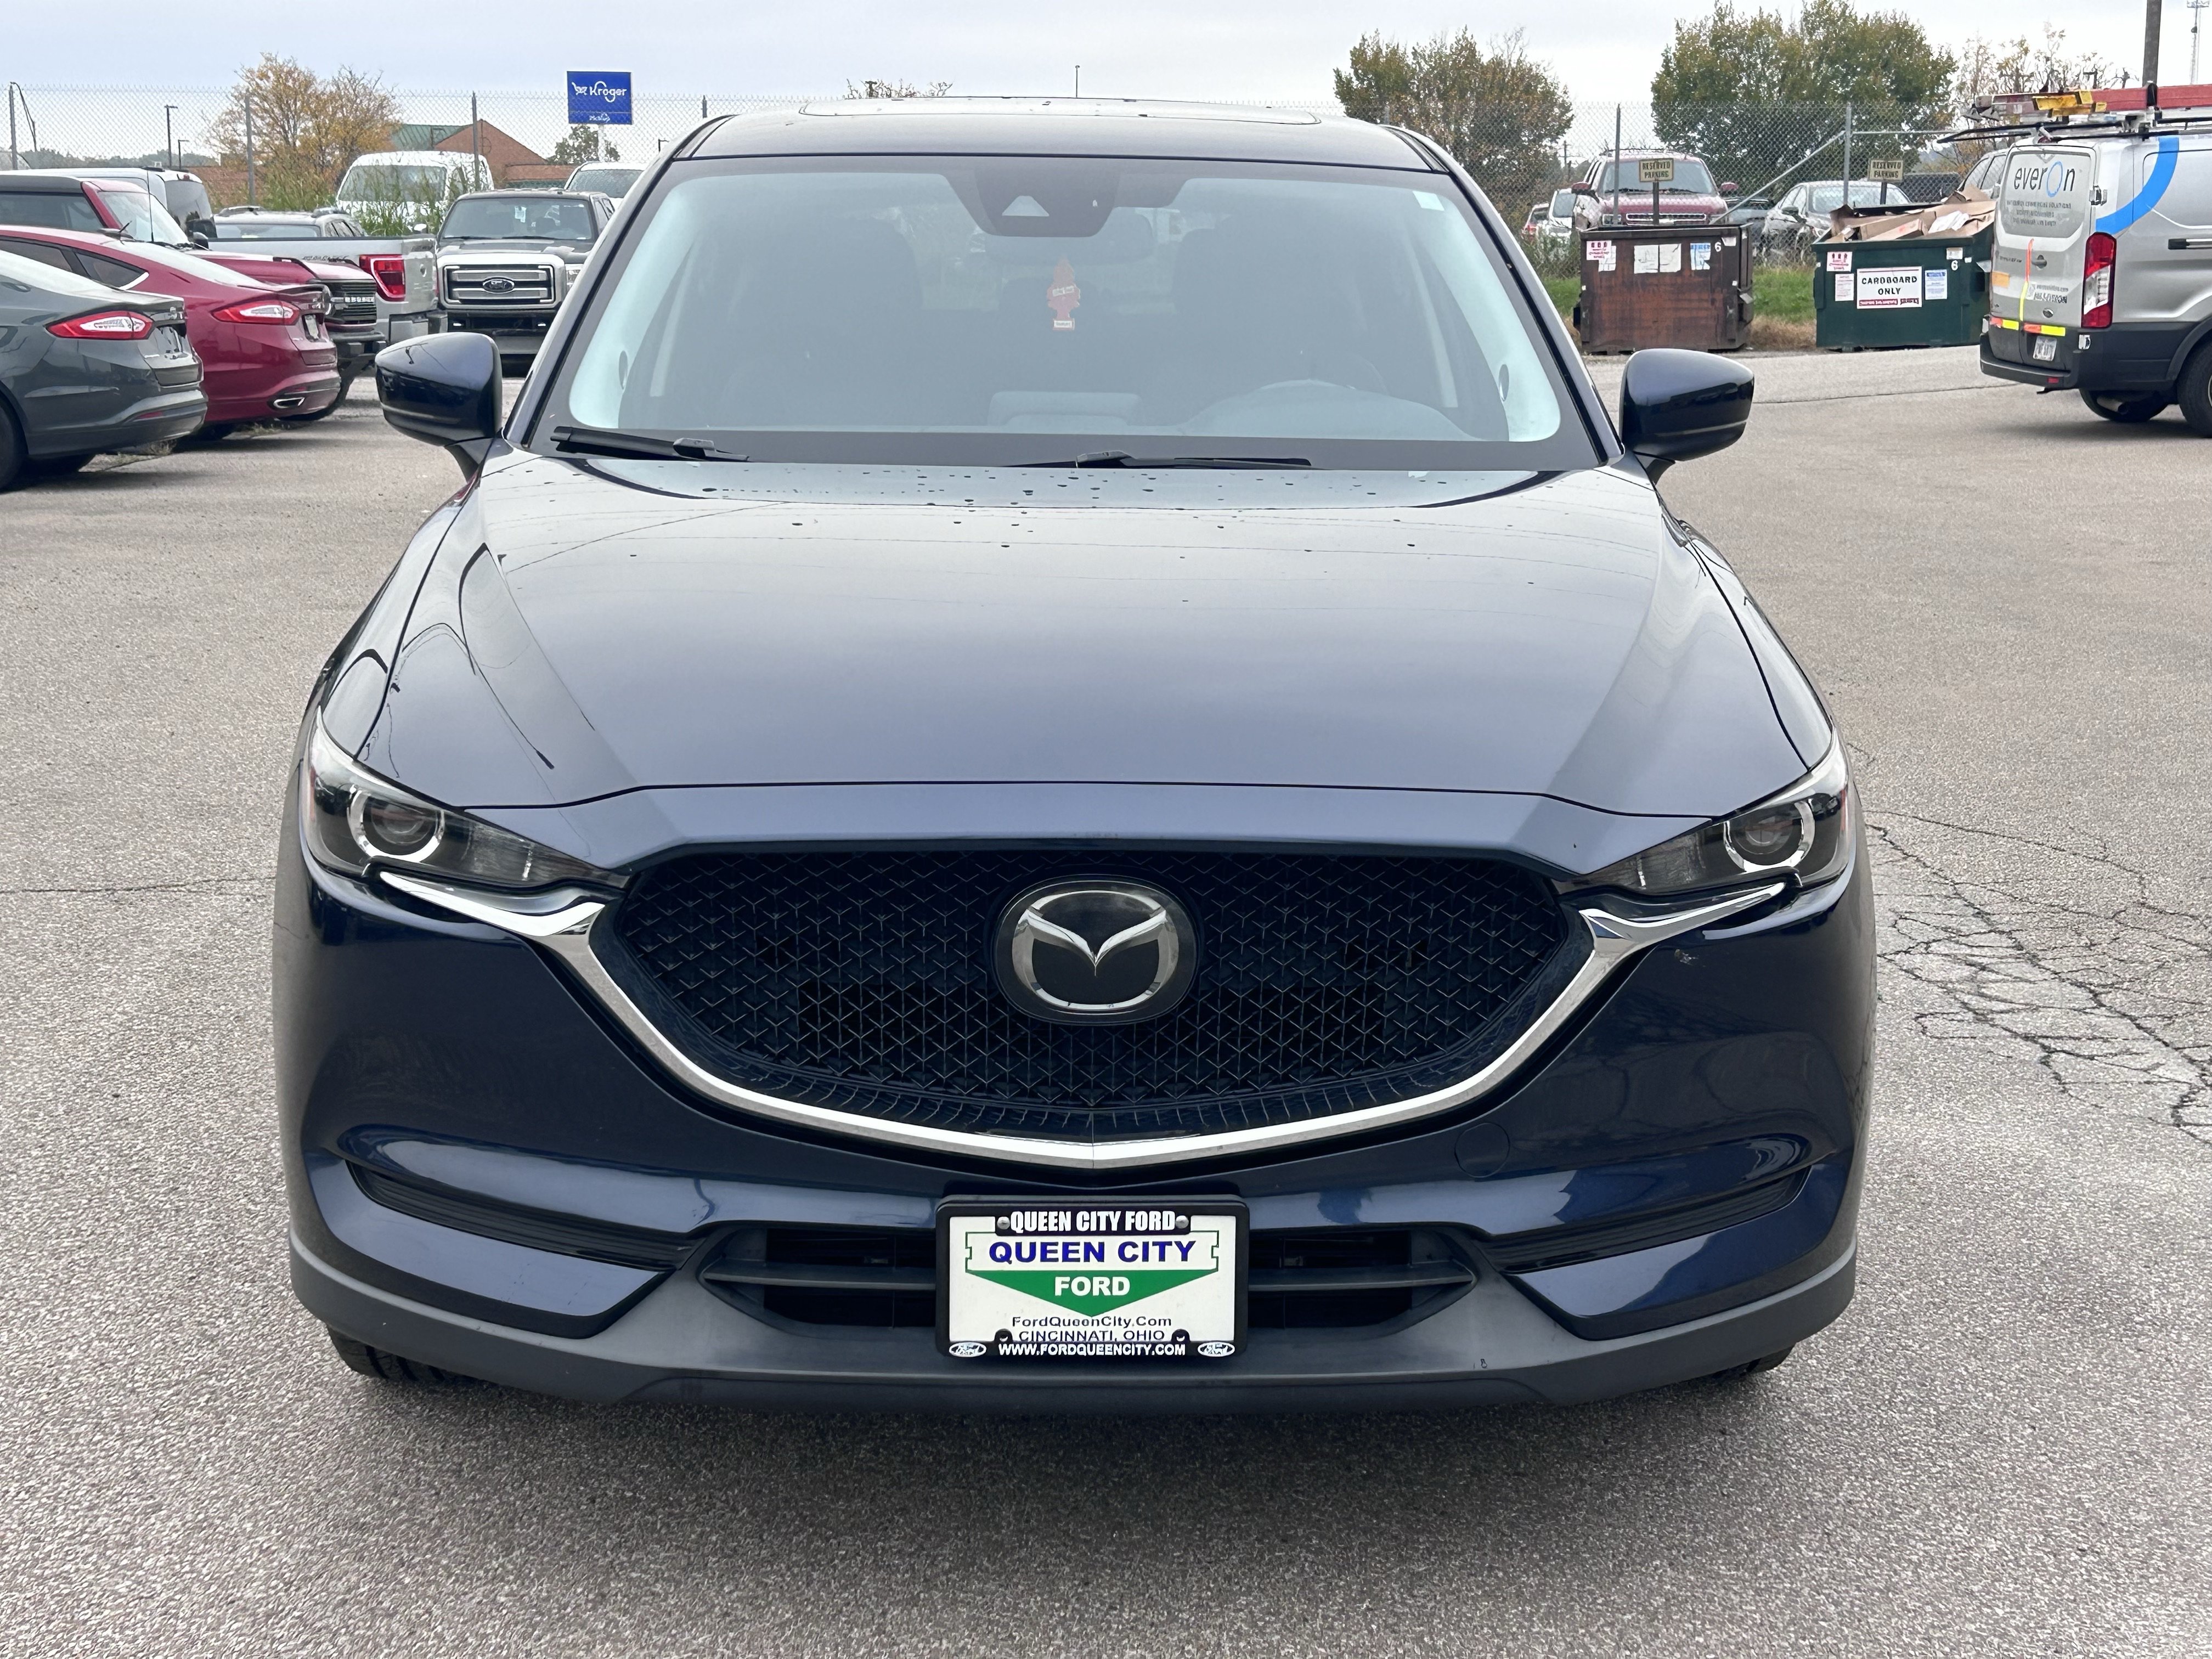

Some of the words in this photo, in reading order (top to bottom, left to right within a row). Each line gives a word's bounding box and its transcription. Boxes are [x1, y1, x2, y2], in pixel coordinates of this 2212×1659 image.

[589, 81, 627, 103] Kroger
[1714, 241, 1722, 252] 6
[1951, 259, 1959, 271] 6
[1861, 276, 1918, 285] CARDBOARD
[1010, 1211, 1071, 1233] QUEEN
[1076, 1211, 1121, 1232] CITY
[1125, 1211, 1176, 1231] FORD
[989, 1241, 1105, 1265] QUEEN
[1118, 1240, 1197, 1262] CITY
[1054, 1276, 1131, 1296] FORD
[1012, 1316, 1172, 1329] FordQueenCity.Com
[1019, 1330, 1117, 1342] CINCINNATI,
[1123, 1330, 1165, 1341] OHIO
[998, 1344, 1186, 1356] WWW.FORDQUEENCITY.COM
